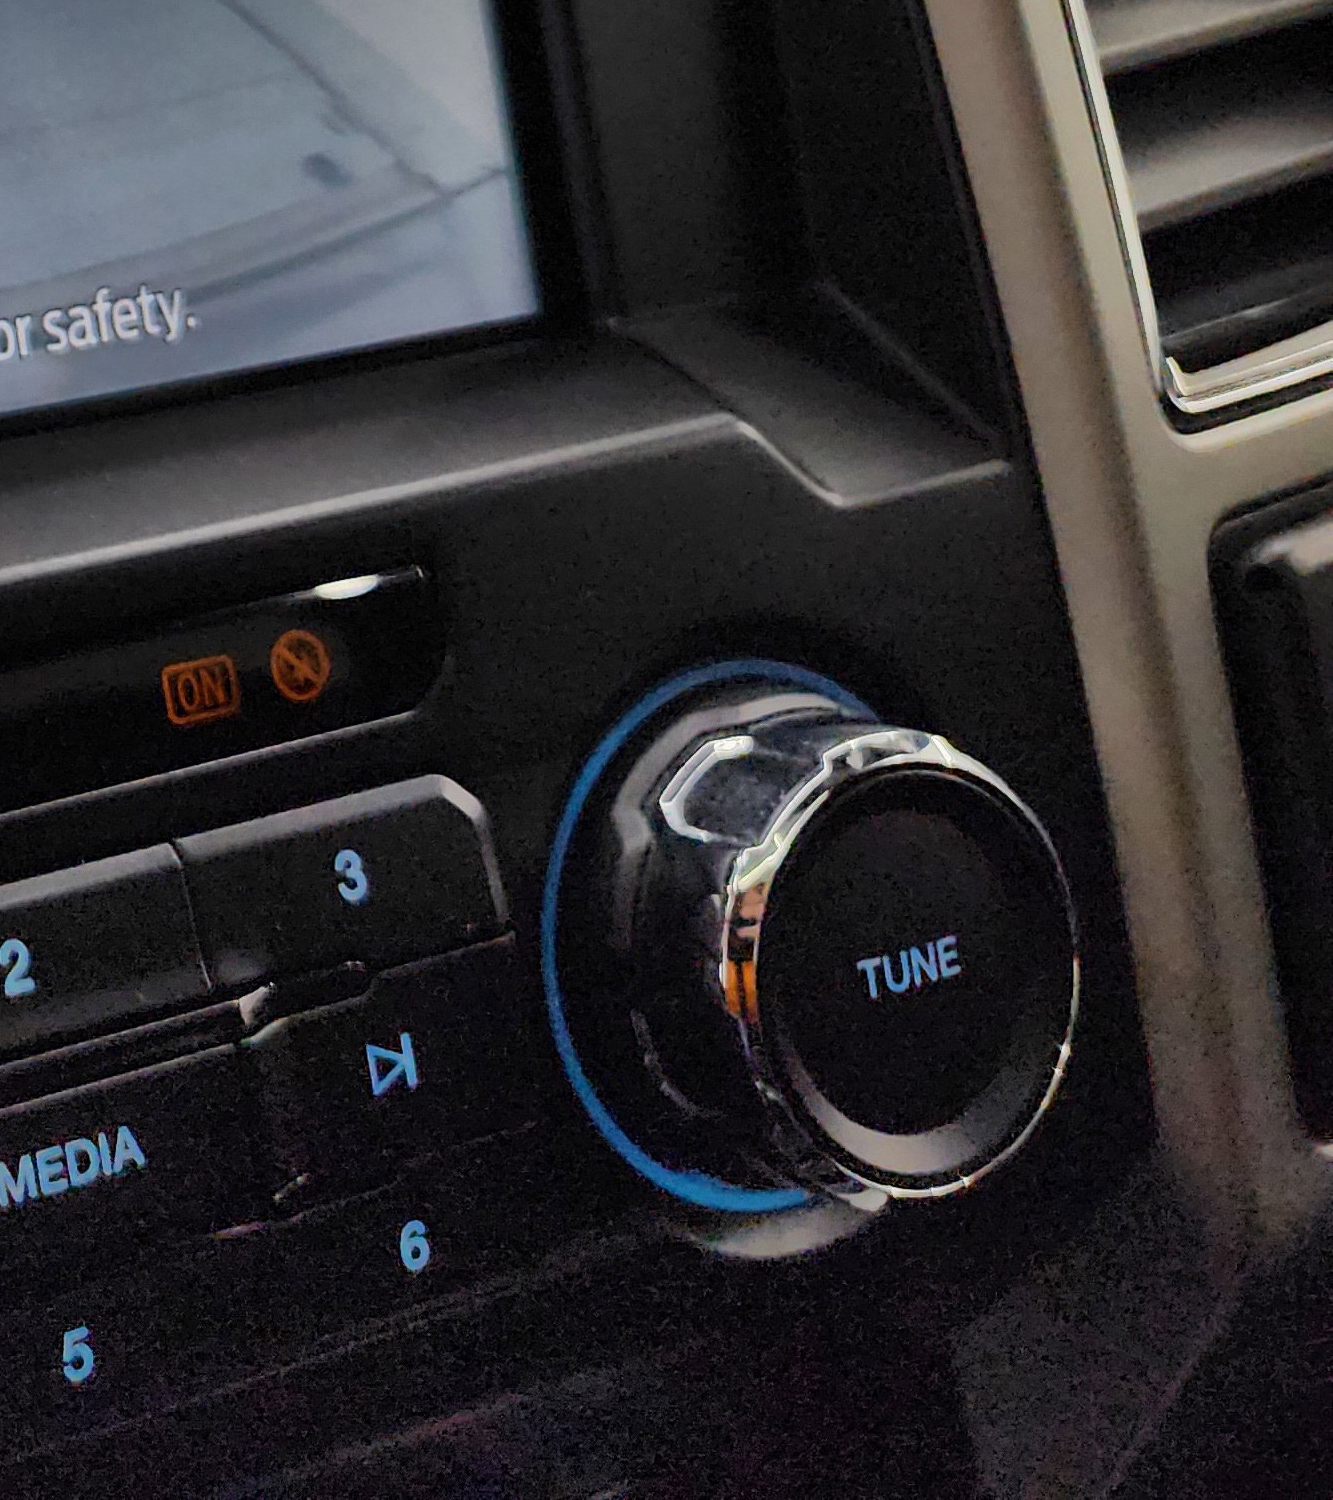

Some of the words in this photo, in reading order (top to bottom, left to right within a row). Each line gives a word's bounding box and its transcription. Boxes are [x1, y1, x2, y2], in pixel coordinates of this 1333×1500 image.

[43, 284, 198, 354] safety.
[175, 668, 228, 710] ON
[334, 849, 368, 903] 3
[856, 934, 962, 999] TUNE
[399, 1219, 431, 1272] 6
[62, 1326, 96, 1383] 5
